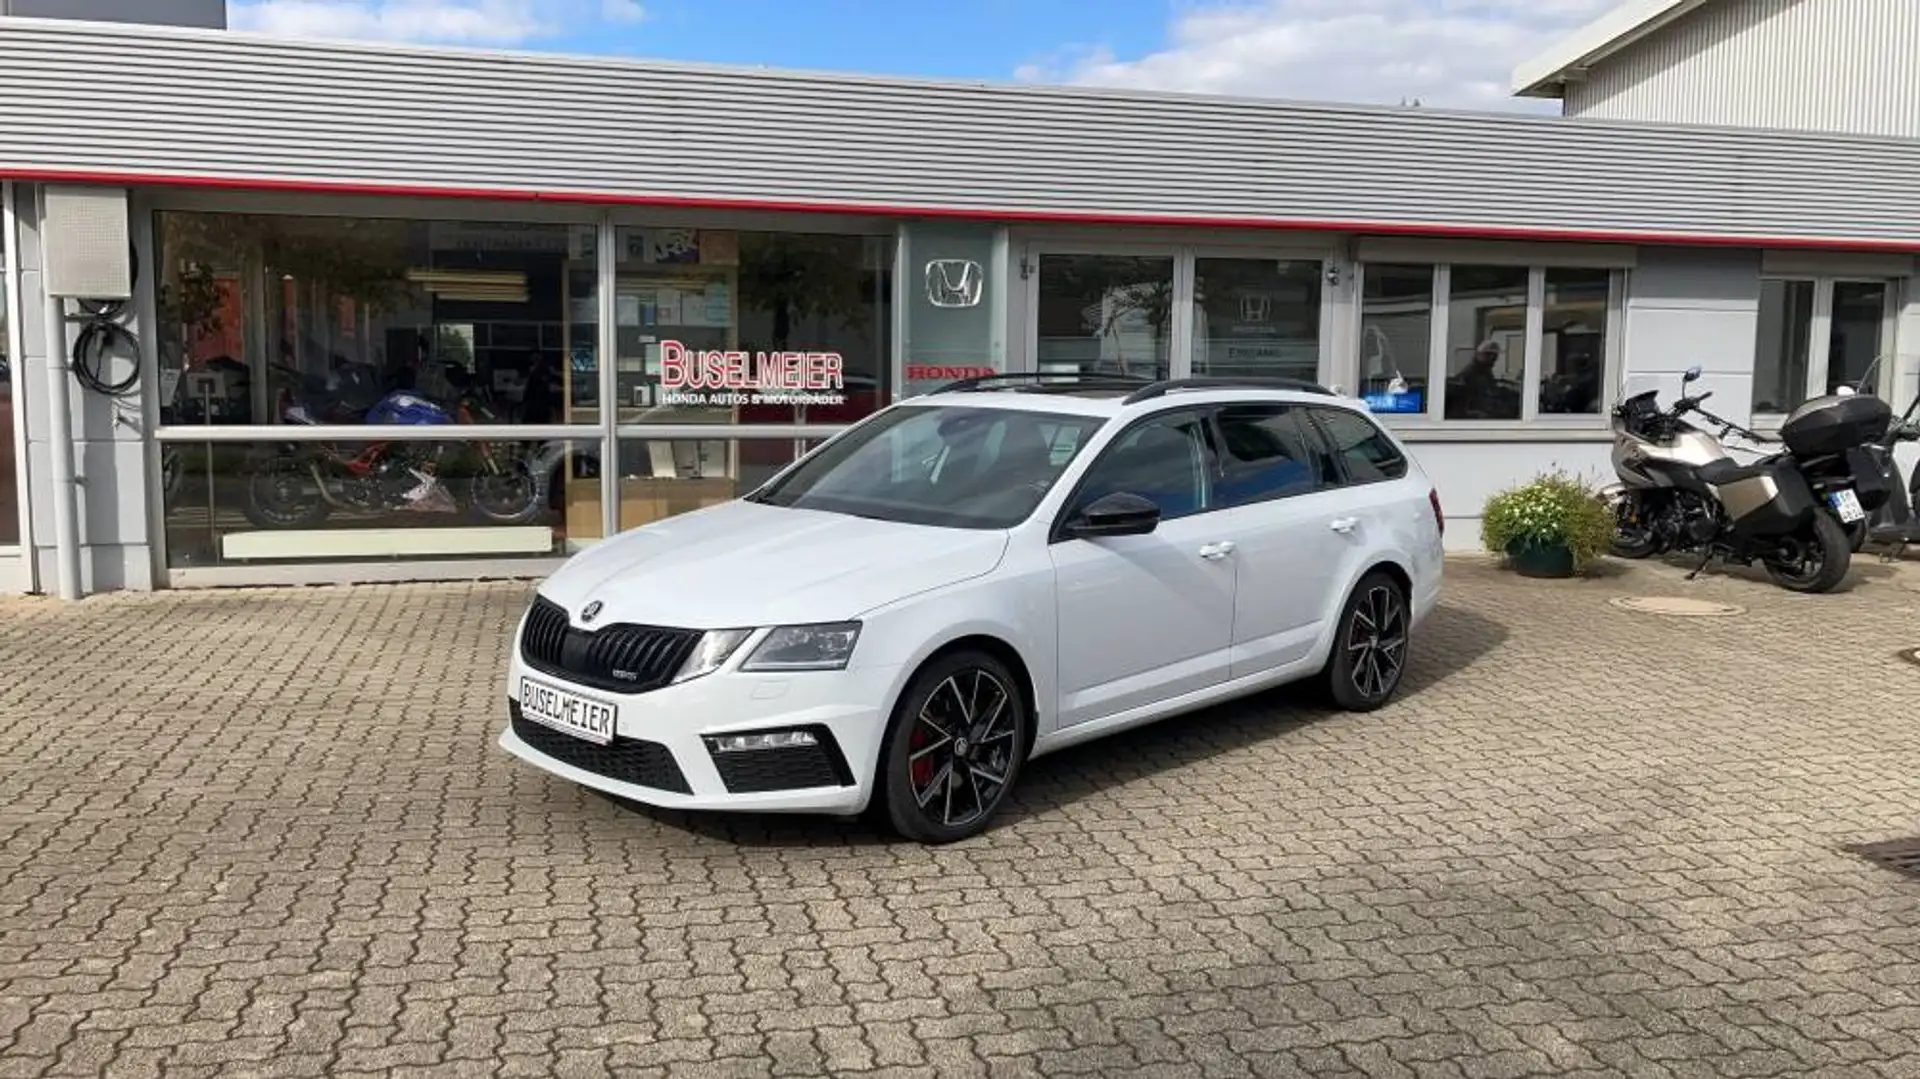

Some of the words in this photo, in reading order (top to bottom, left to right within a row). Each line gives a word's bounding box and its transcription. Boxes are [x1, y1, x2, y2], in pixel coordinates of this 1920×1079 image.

[660, 340, 844, 389] BUSELMEIER
[907, 366, 996, 380] HONDA
[662, 394, 706, 405] HONDA
[709, 394, 748, 405] AUTOS
[524, 683, 609, 734] BUSELMEIER
